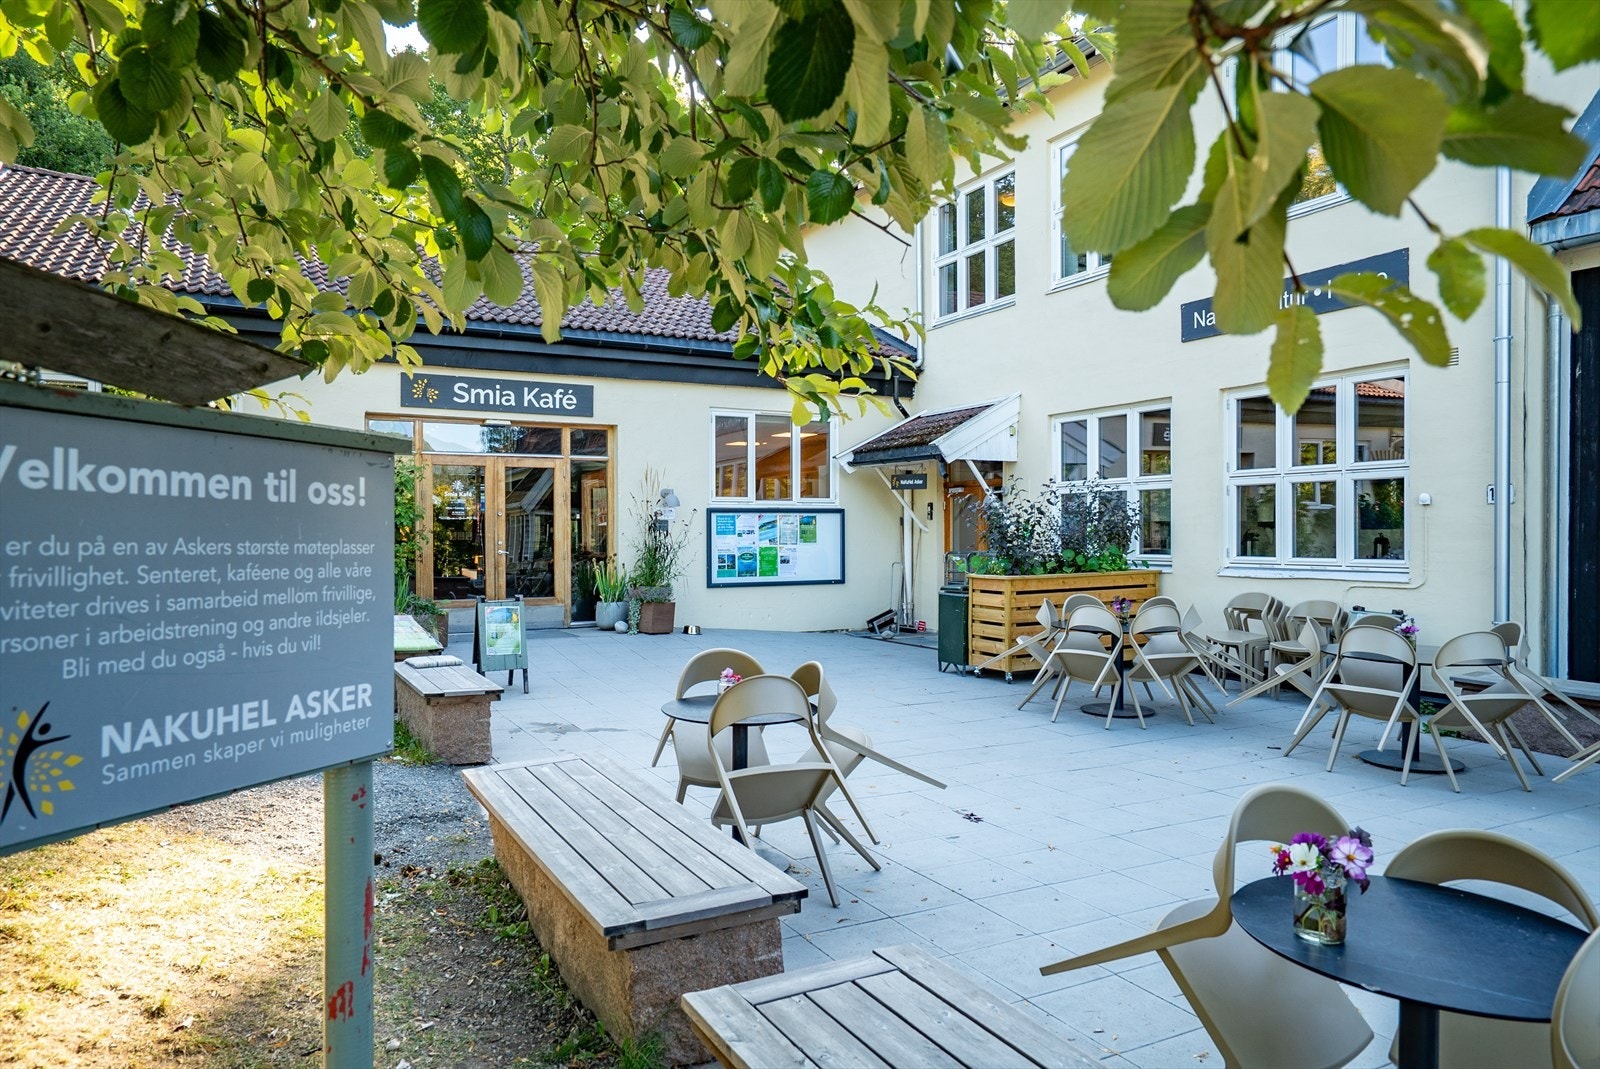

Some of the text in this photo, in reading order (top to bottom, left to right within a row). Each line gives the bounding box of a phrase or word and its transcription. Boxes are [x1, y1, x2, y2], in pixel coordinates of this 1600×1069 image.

[453, 382, 577, 410] Smia Kafé
[264, 469, 296, 502] til
[308, 477, 365, 506] oss!
[6, 535, 375, 562] er du på en av Askers største møteplasser
[8, 562, 371, 592] frivillighet. Senteret, kaféene og alle våre
[86, 595, 149, 616] drives
[156, 594, 159, 611] i
[167, 589, 257, 611] samarbeid
[264, 587, 317, 605] mellom
[322, 585, 375, 604] frivillige,
[86, 628, 90, 646] i
[98, 617, 237, 647] arbeidstrening
[243, 620, 264, 636] og
[269, 612, 311, 630] andre
[316, 608, 369, 628] ildsjeler.
[63, 657, 89, 679] Bli
[98, 653, 145, 674] med
[152, 649, 176, 669] du
[183, 644, 225, 669] også
[243, 641, 273, 658] hvis
[278, 637, 296, 654] du
[302, 634, 320, 651] vil!
[102, 683, 372, 758] NAKUHEL ASKER
[102, 715, 371, 785] Sammen skaper vi muligheter
